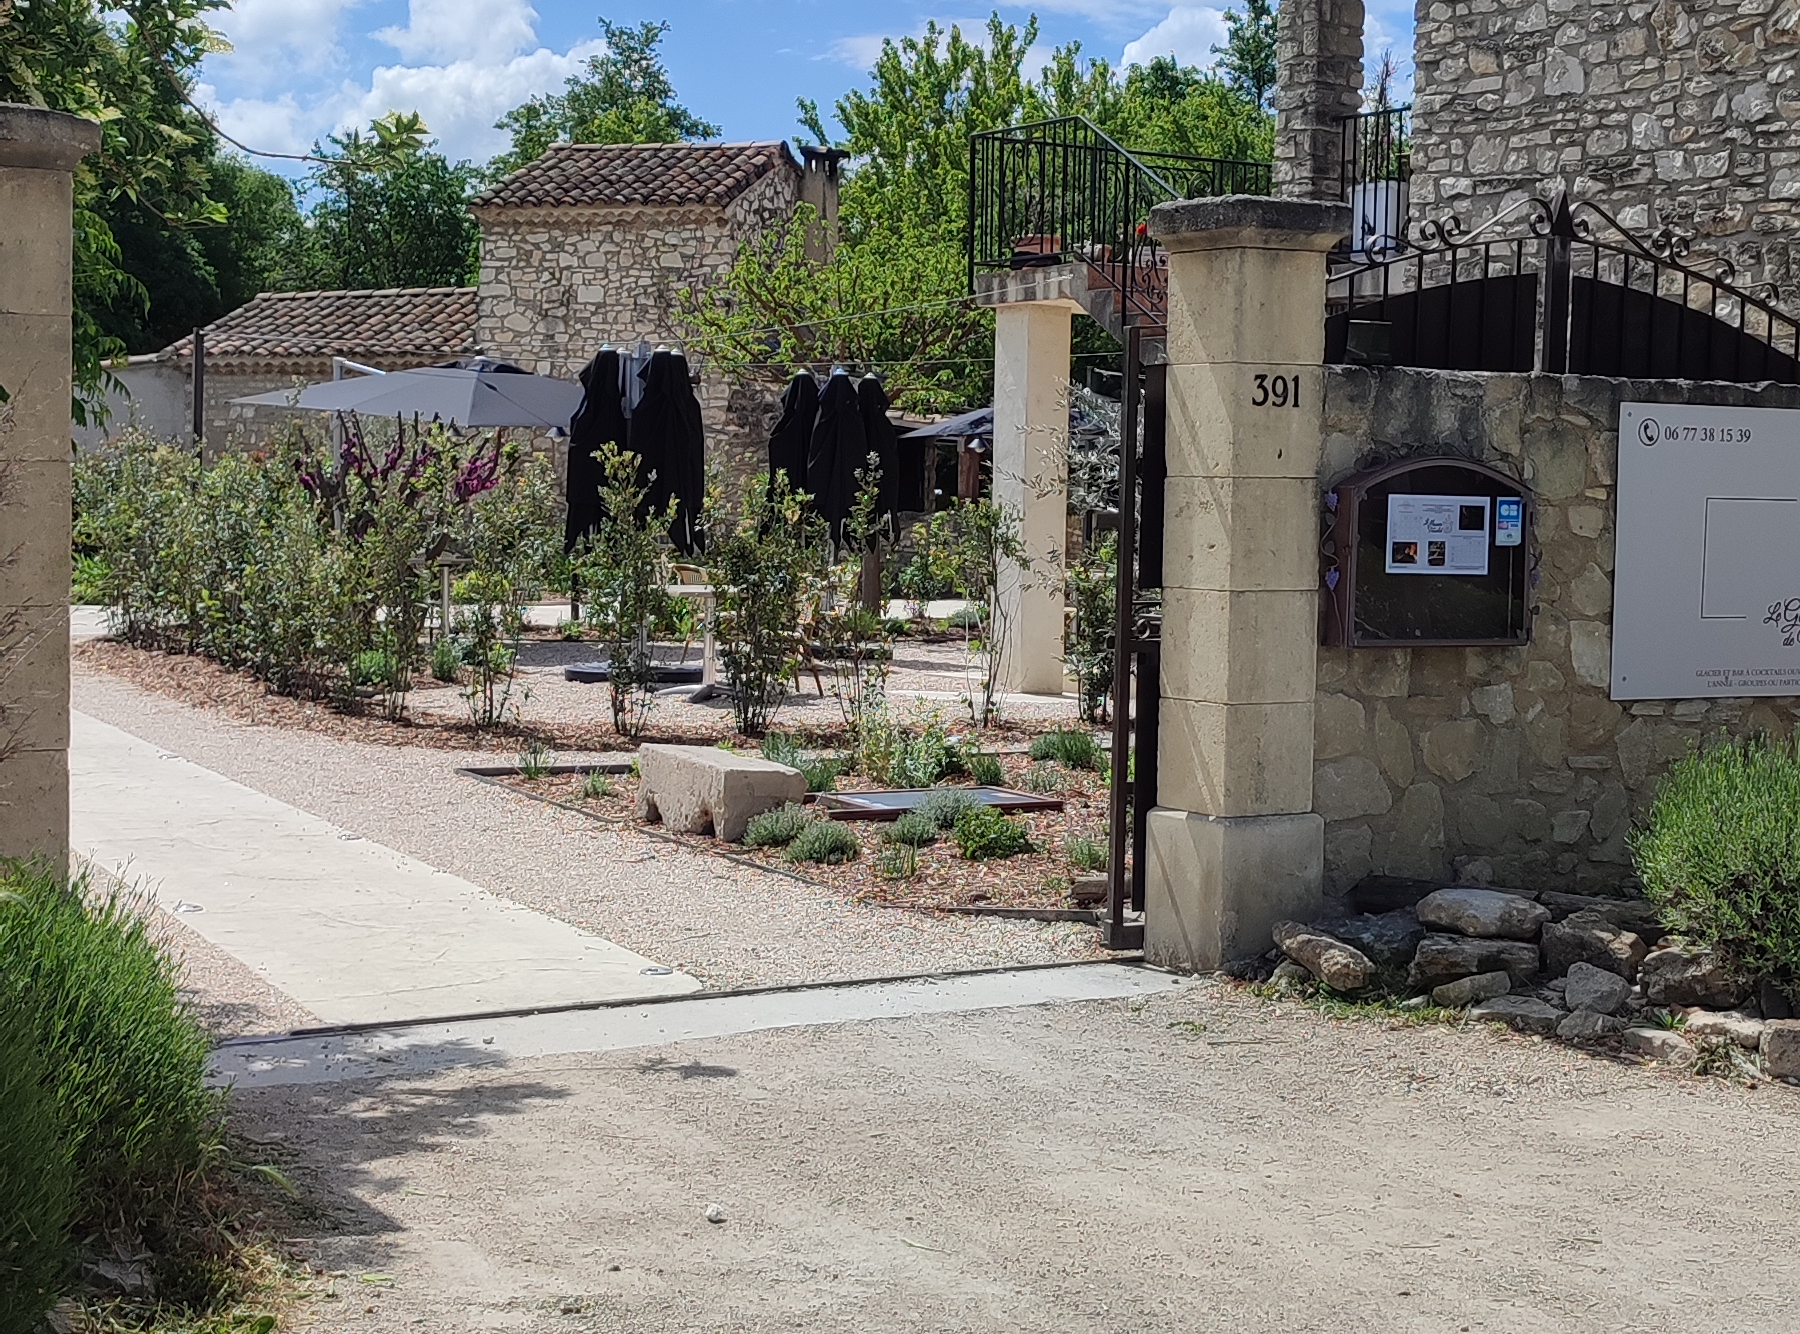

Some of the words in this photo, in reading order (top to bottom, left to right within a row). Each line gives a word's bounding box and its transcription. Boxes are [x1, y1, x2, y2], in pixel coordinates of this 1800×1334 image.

[1251, 373, 1300, 408] 391
[1664, 426, 1679, 441] 06
[1682, 427, 1698, 441] 77
[1700, 427, 1715, 442] 38
[1720, 428, 1733, 442] 15
[1736, 428, 1751, 443] 39
[1782, 631, 1795, 647] de
[1751, 668, 1787, 676] COCKTAILS
